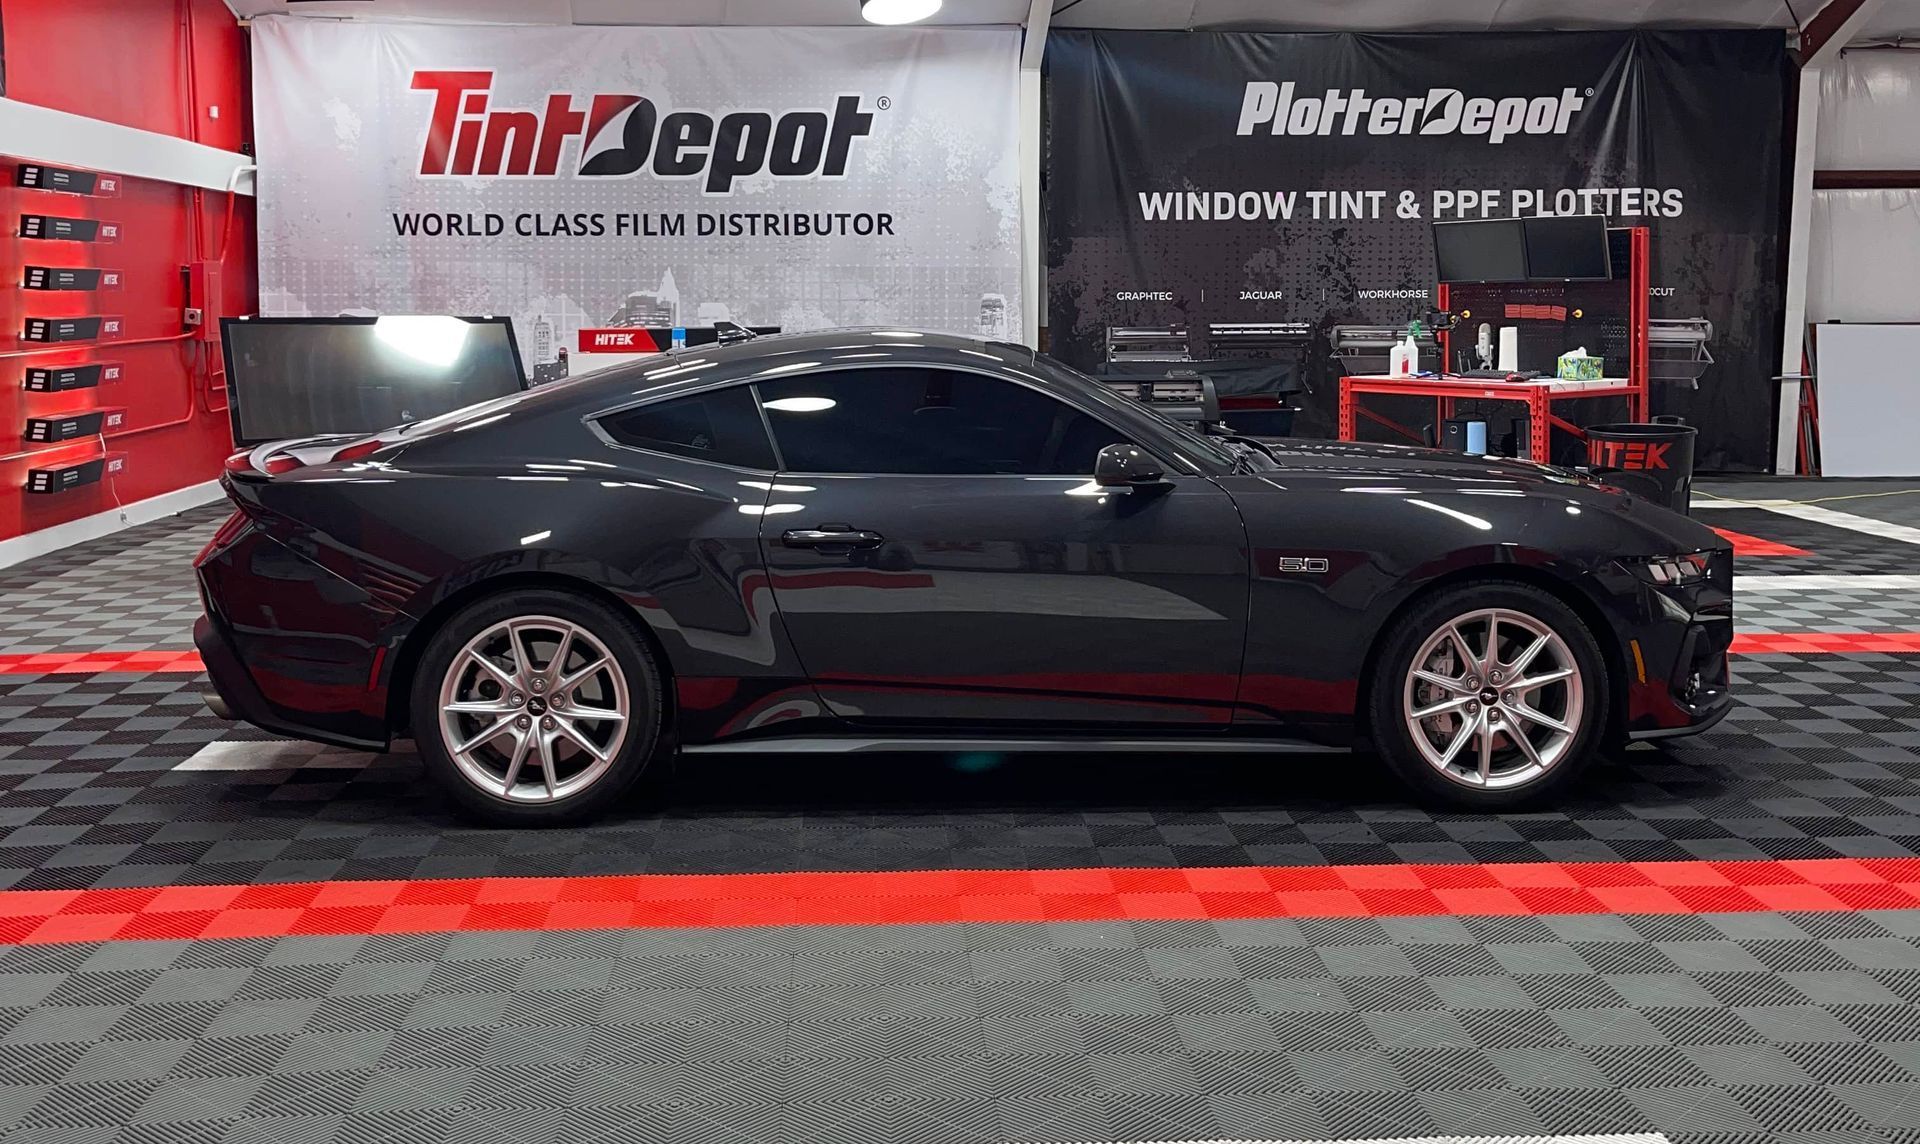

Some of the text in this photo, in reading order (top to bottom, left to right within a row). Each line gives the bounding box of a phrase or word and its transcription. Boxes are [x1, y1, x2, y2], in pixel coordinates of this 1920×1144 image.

[1138, 187, 1684, 221] WINDOW TINT & PPF PLOTTERS
[392, 213, 895, 237] WORLD CLASS FILM DISTRIBUTOR
[1116, 290, 1173, 301] GRAPHTEC
[1239, 290, 1283, 300] JAGUAR
[1357, 289, 1429, 299] WORKHORSE
[595, 333, 635, 346] HITEK
[1279, 556, 1329, 573] 5.0
